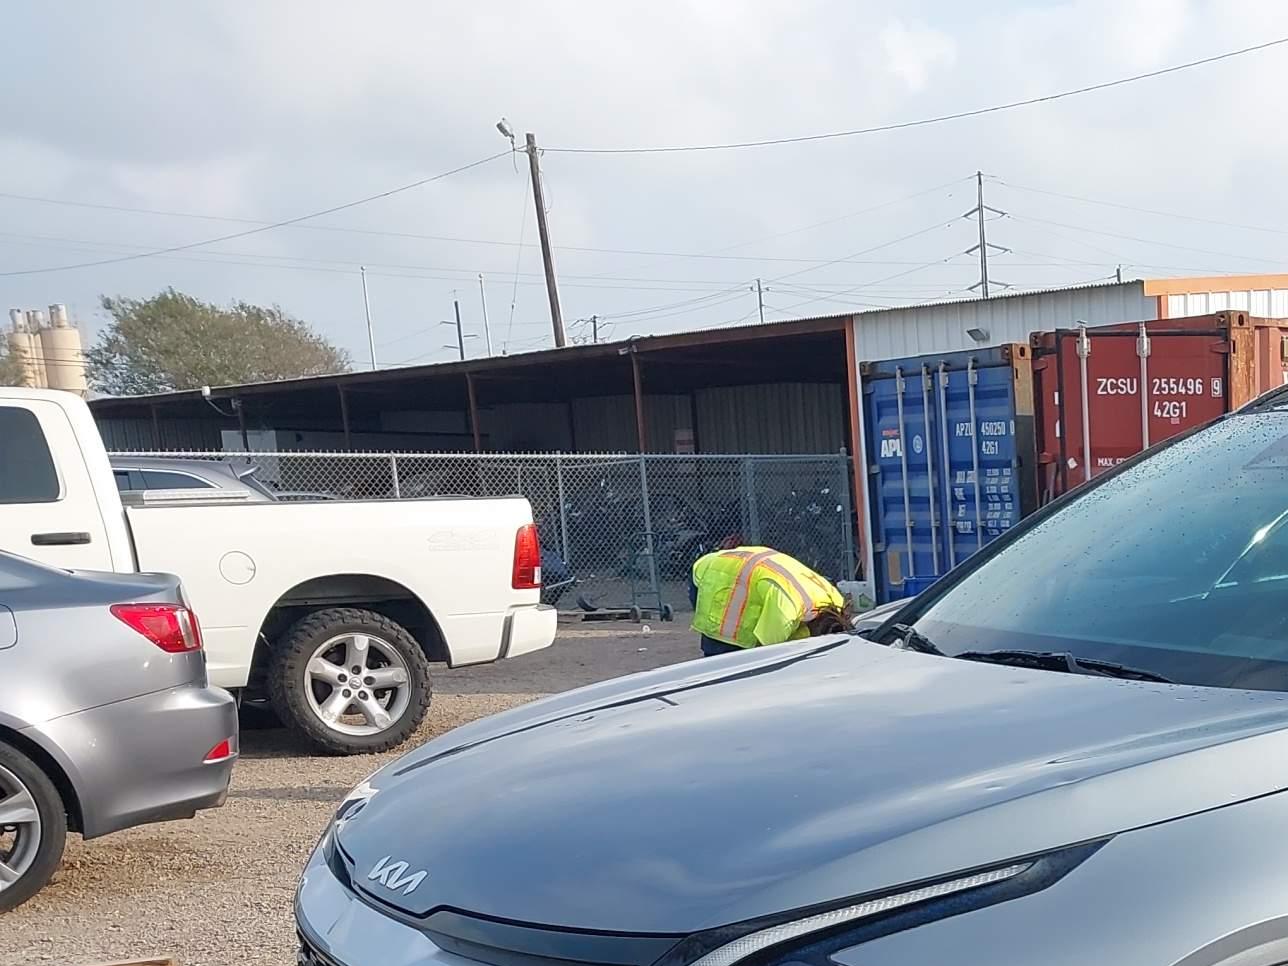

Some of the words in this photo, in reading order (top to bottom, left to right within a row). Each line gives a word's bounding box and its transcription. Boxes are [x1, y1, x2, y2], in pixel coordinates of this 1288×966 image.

[1097, 378, 1137, 395] ZCSU
[1153, 377, 1203, 395] 255496
[1154, 401, 1187, 418] 42G1
[981, 421, 1006, 436] 450250
[881, 439, 902, 458] APL
[981, 440, 999, 455] 42G1
[367, 855, 428, 896] KIA
